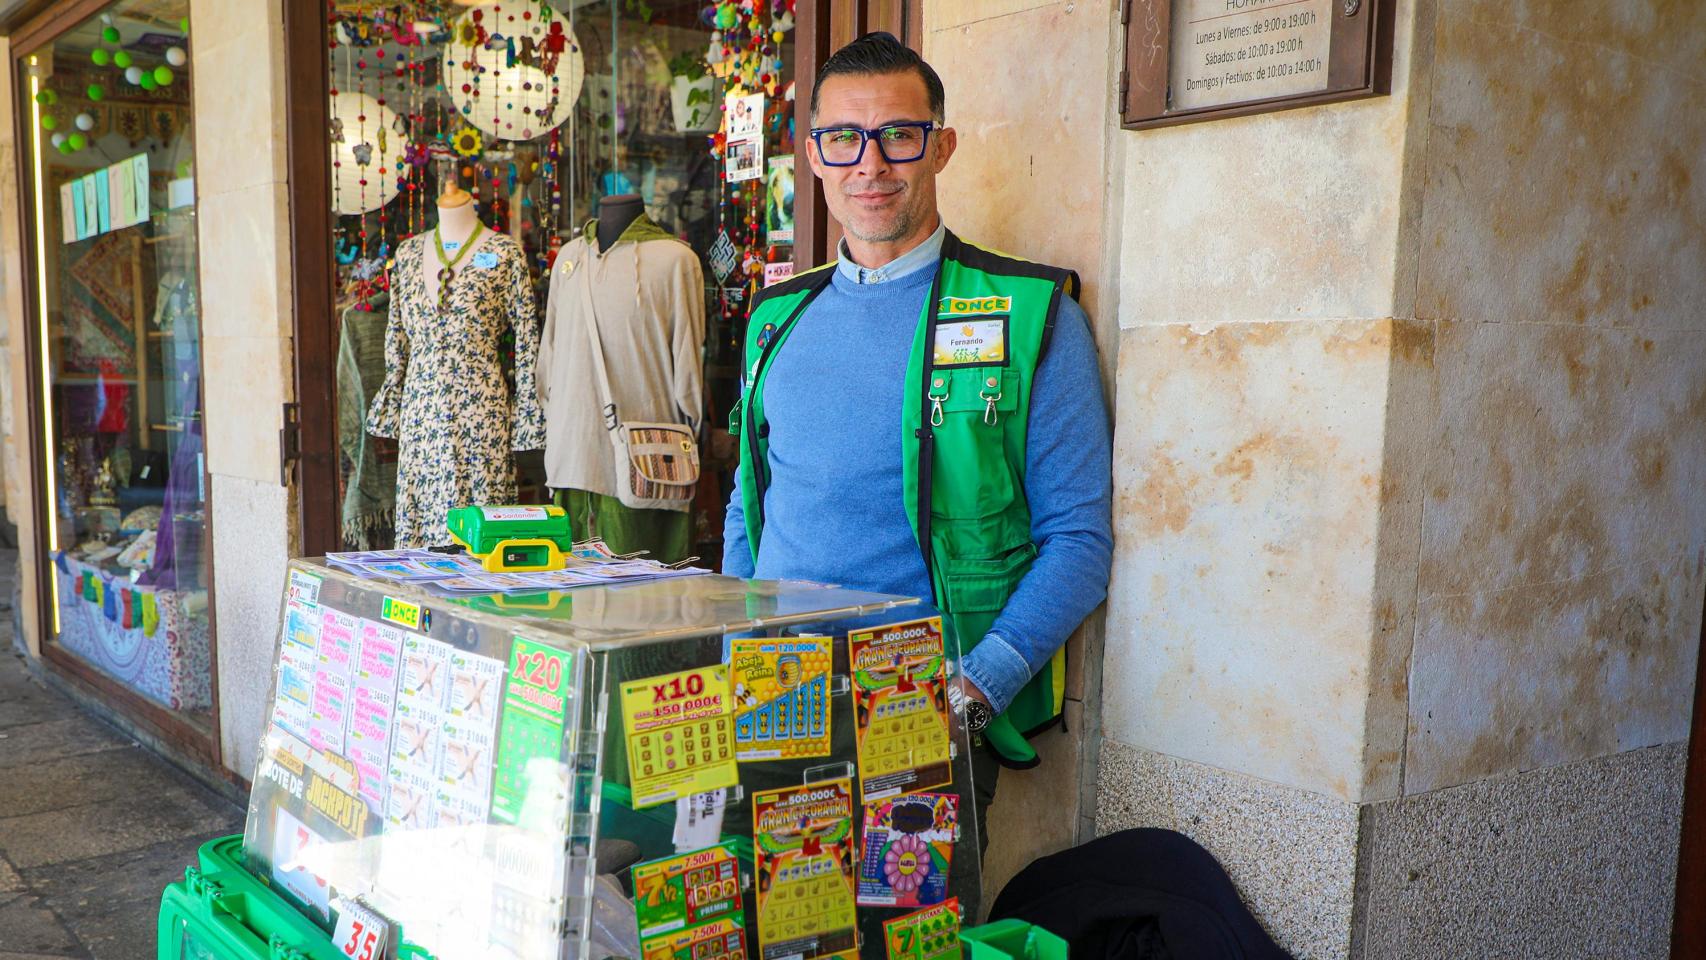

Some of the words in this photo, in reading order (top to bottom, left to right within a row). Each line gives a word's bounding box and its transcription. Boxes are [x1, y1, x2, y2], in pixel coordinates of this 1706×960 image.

[1196, 32, 1216, 45] Lunes
[1223, 26, 1252, 40] Viernes:
[1253, 19, 1263, 34] de
[1264, 17, 1281, 32] 9:00
[1281, 19, 1287, 28] a
[1288, 11, 1310, 29] 19:00
[1310, 10, 1316, 25] h
[1205, 50, 1236, 66] Sábados:
[1237, 47, 1247, 61] de
[1248, 43, 1268, 59] 10:00
[1269, 46, 1274, 55] a
[1276, 38, 1297, 54] 19:00
[1298, 36, 1303, 50] h
[1186, 75, 1219, 91] Domingos
[1220, 76, 1224, 88] y
[1225, 70, 1255, 85] Festivos:
[1256, 66, 1266, 80] de
[1267, 63, 1287, 78] 10:00
[1288, 65, 1293, 75] a
[1294, 58, 1315, 75] 14:00
[1316, 56, 1322, 71] h
[954, 298, 1007, 312] ONCE
[950, 338, 984, 346] Fernando
[393, 603, 418, 624] ONCE
[882, 627, 927, 642] 500.000€
[736, 654, 763, 670] Abeja
[746, 667, 773, 680] Reina
[654, 694, 722, 716] 150000€
[289, 776, 304, 799] DE
[788, 789, 835, 805] 500.000€
[700, 902, 729, 917] PREMIO
[344, 920, 378, 960] 35
